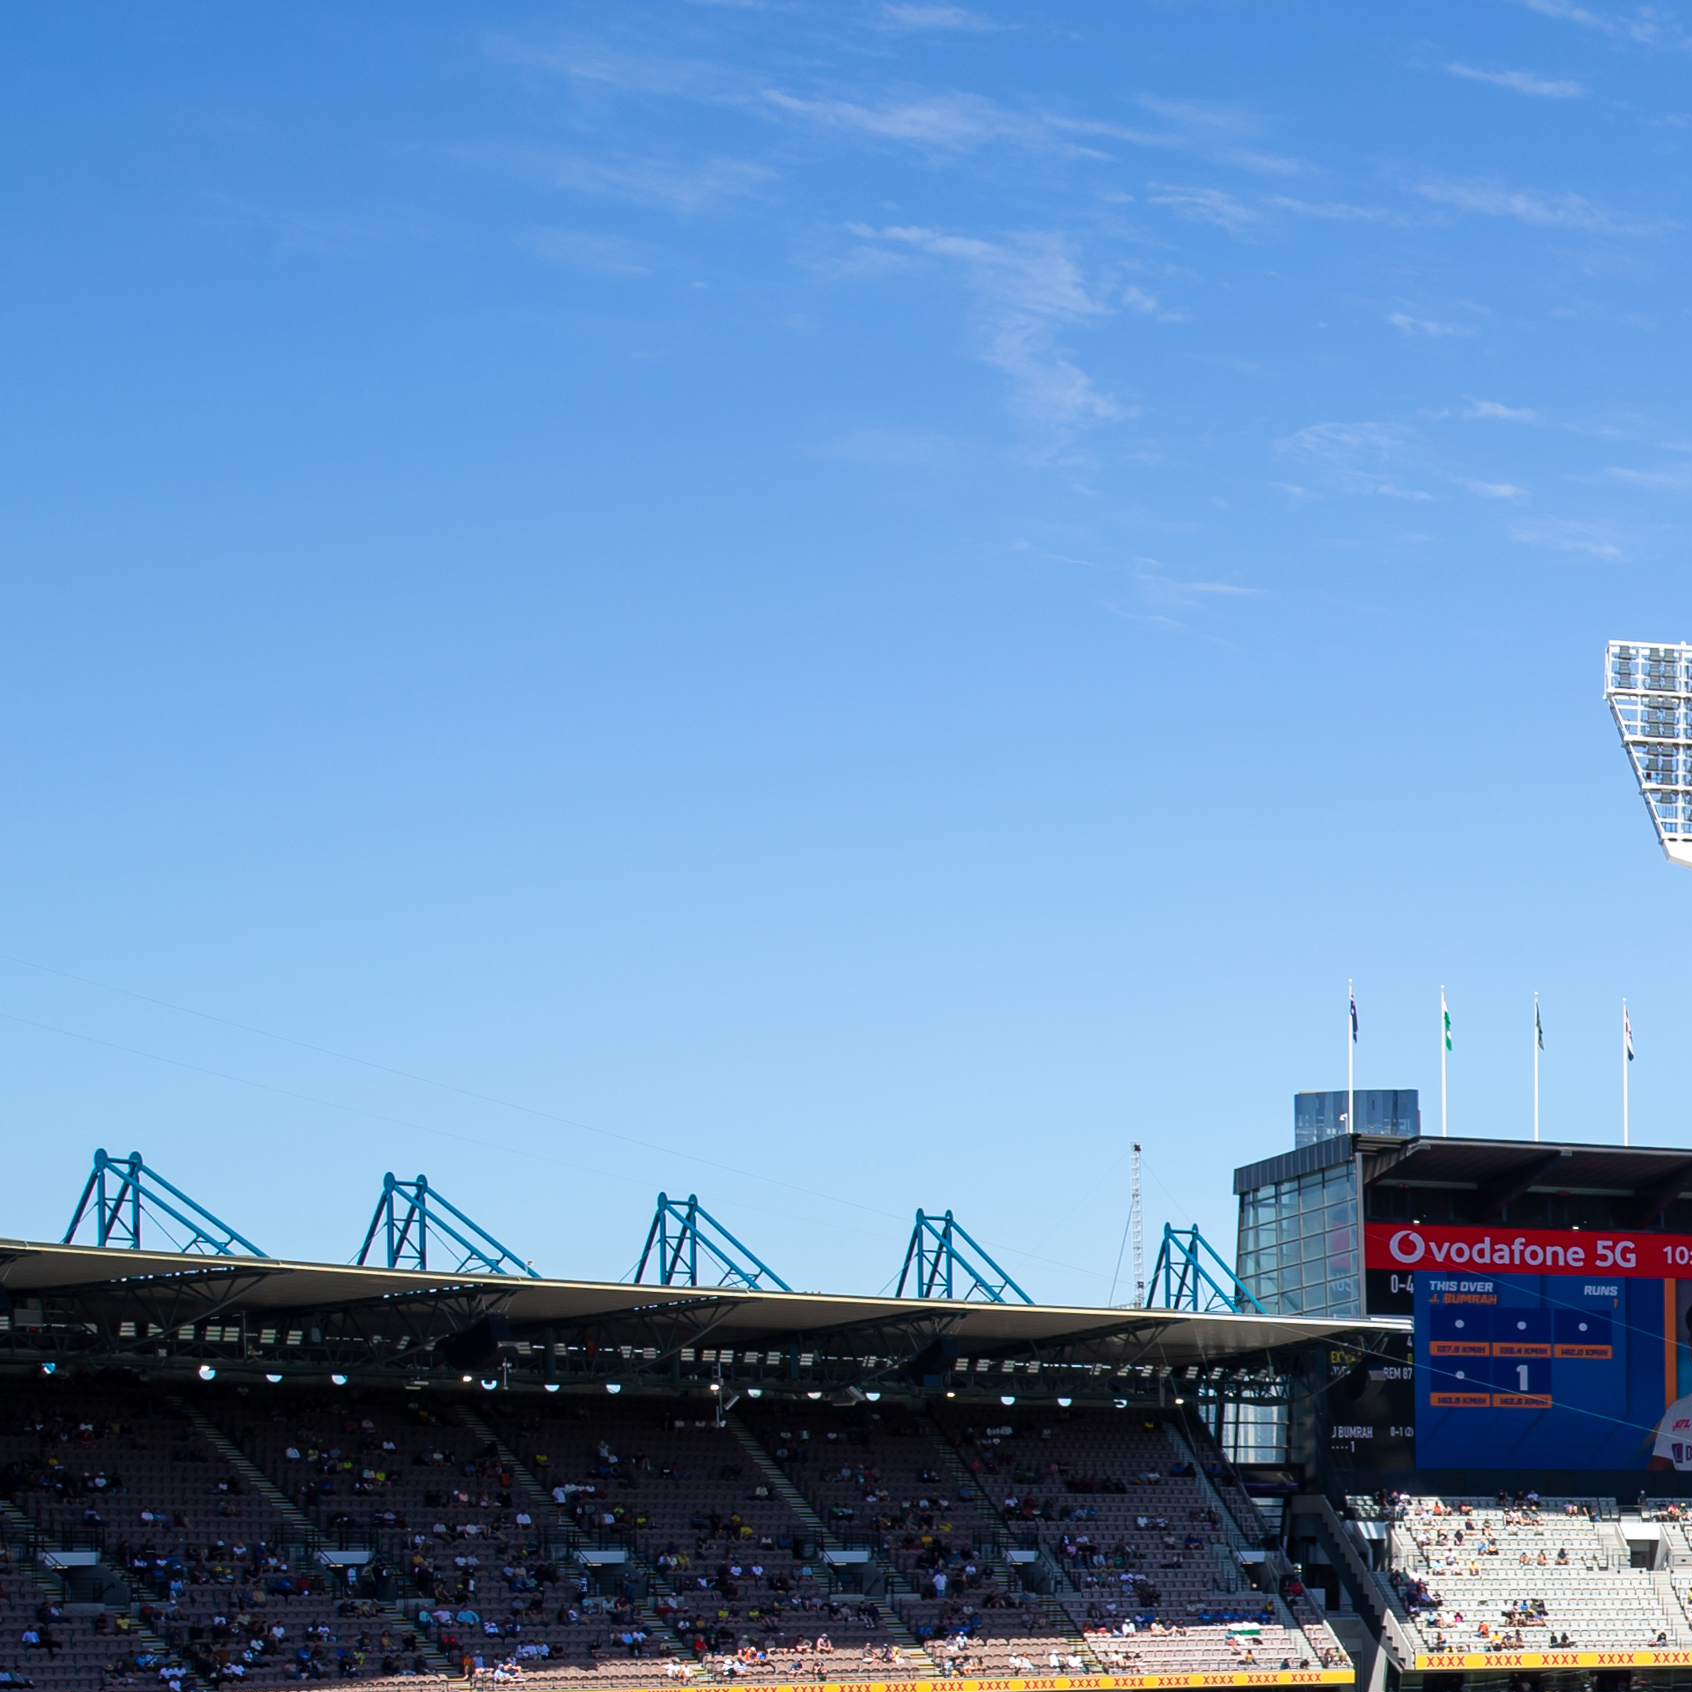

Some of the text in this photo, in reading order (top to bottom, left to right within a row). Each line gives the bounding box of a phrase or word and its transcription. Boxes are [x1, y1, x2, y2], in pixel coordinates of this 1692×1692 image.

[1429, 1238, 1585, 1267] vodafone
[1595, 1240, 1636, 1268] 5G
[1390, 1274, 1414, 1294] 0-4
[1429, 1280, 1494, 1292] THIS OVER
[1584, 1286, 1618, 1296] RUNS
[1443, 1294, 1497, 1304] BUMRAH
[1407, 1336, 1412, 1346] 4
[1384, 1367, 1412, 1380] REM 87
[1516, 1365, 1528, 1390] 1
[1332, 1426, 1373, 1438] J BUMRAH
[1390, 1426, 1403, 1436] 0-1
[1427, 1657, 1464, 1667] XXXX
[1159, 1677, 1189, 1686] XXXX
[886, 1683, 917, 1692] XXXX
